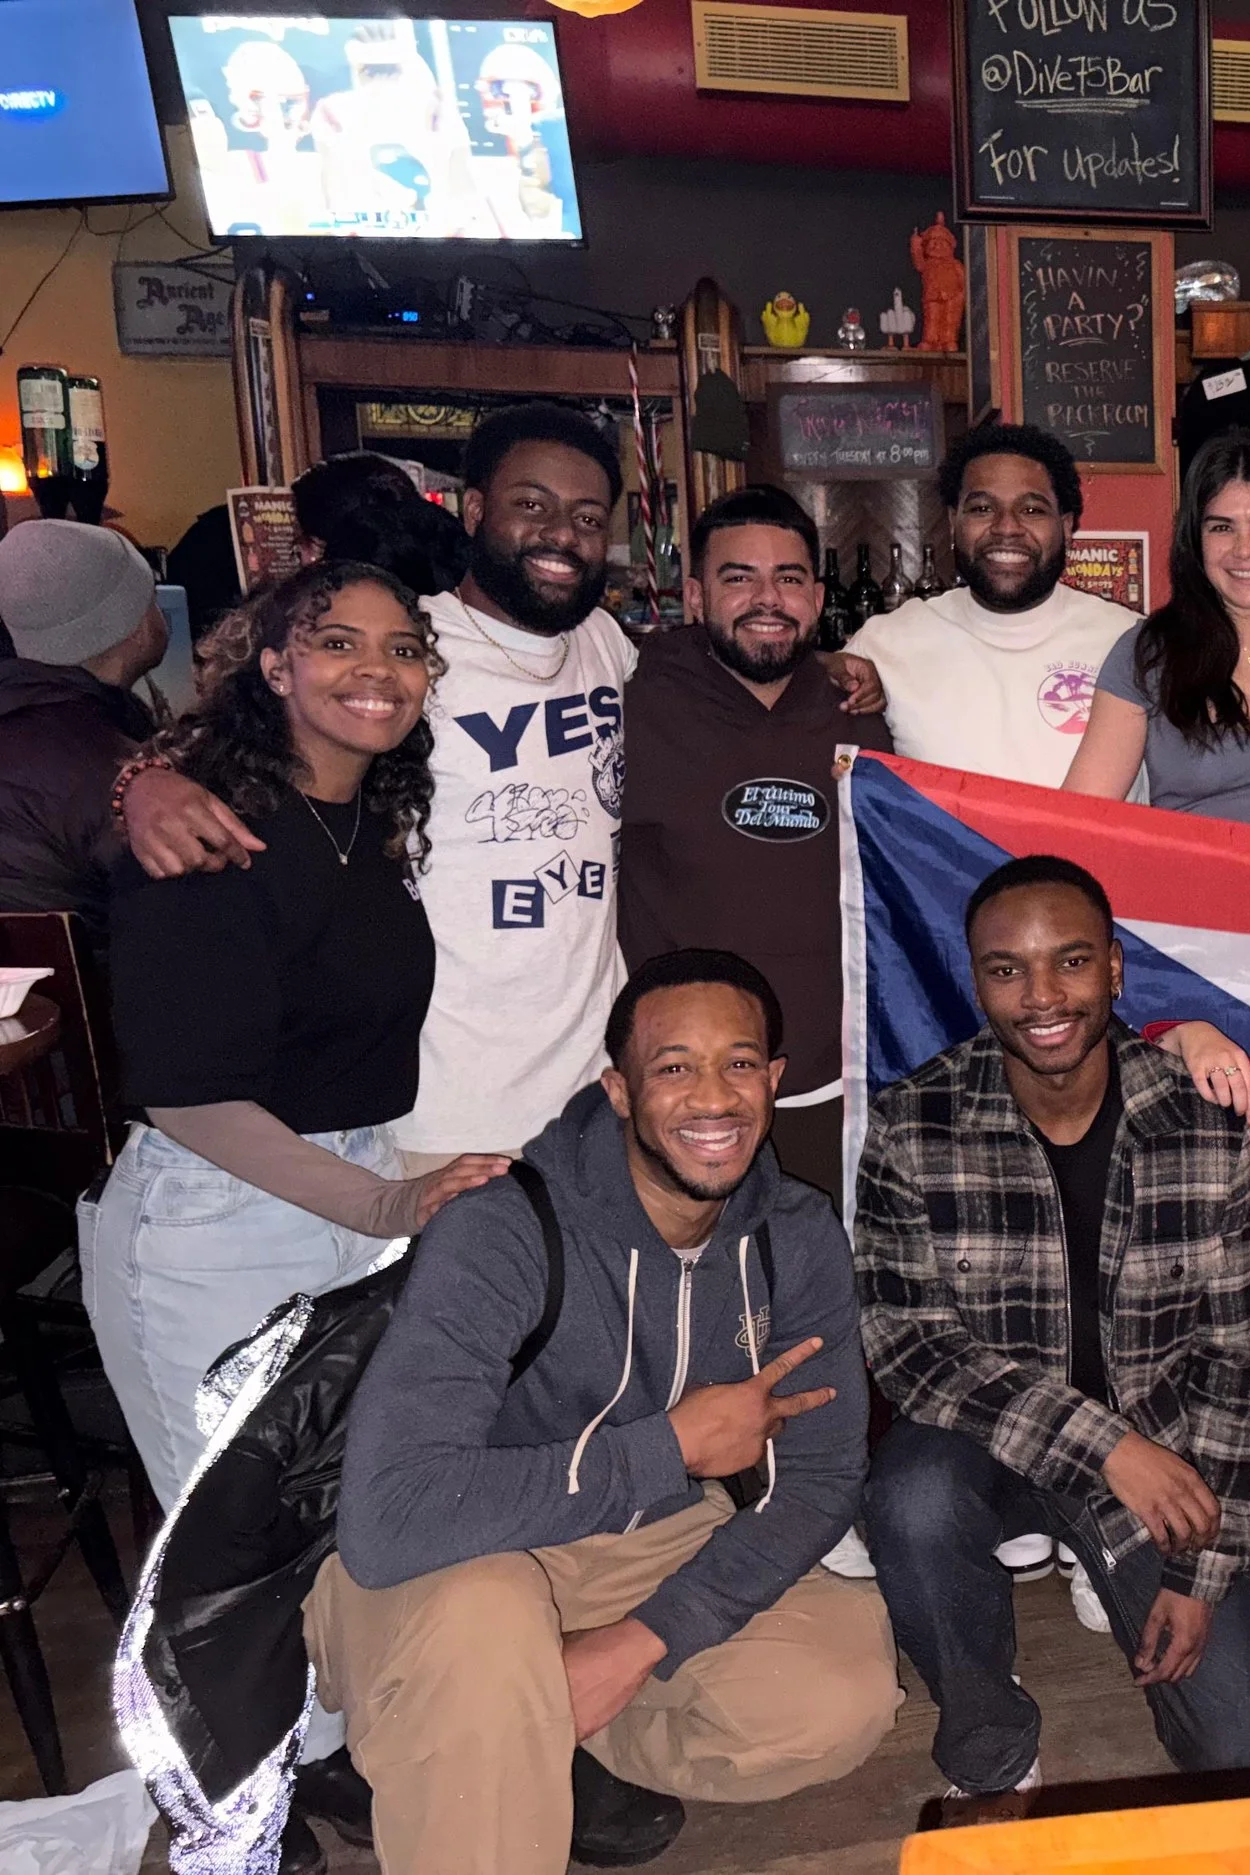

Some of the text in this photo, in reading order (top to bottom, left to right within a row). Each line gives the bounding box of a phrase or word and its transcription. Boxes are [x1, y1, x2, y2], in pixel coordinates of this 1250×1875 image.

[1067, 291, 1086, 312] A
[1045, 359, 1137, 383] RESERVE
[1069, 549, 1118, 562] MANIC
[1066, 562, 1124, 577] MONDAYS
[452, 686, 623, 774] YES
[741, 786, 760, 803] El
[735, 808, 820, 829] Del Mundo
[760, 801, 798, 815] Tour
[500, 857, 604, 925] EYE
